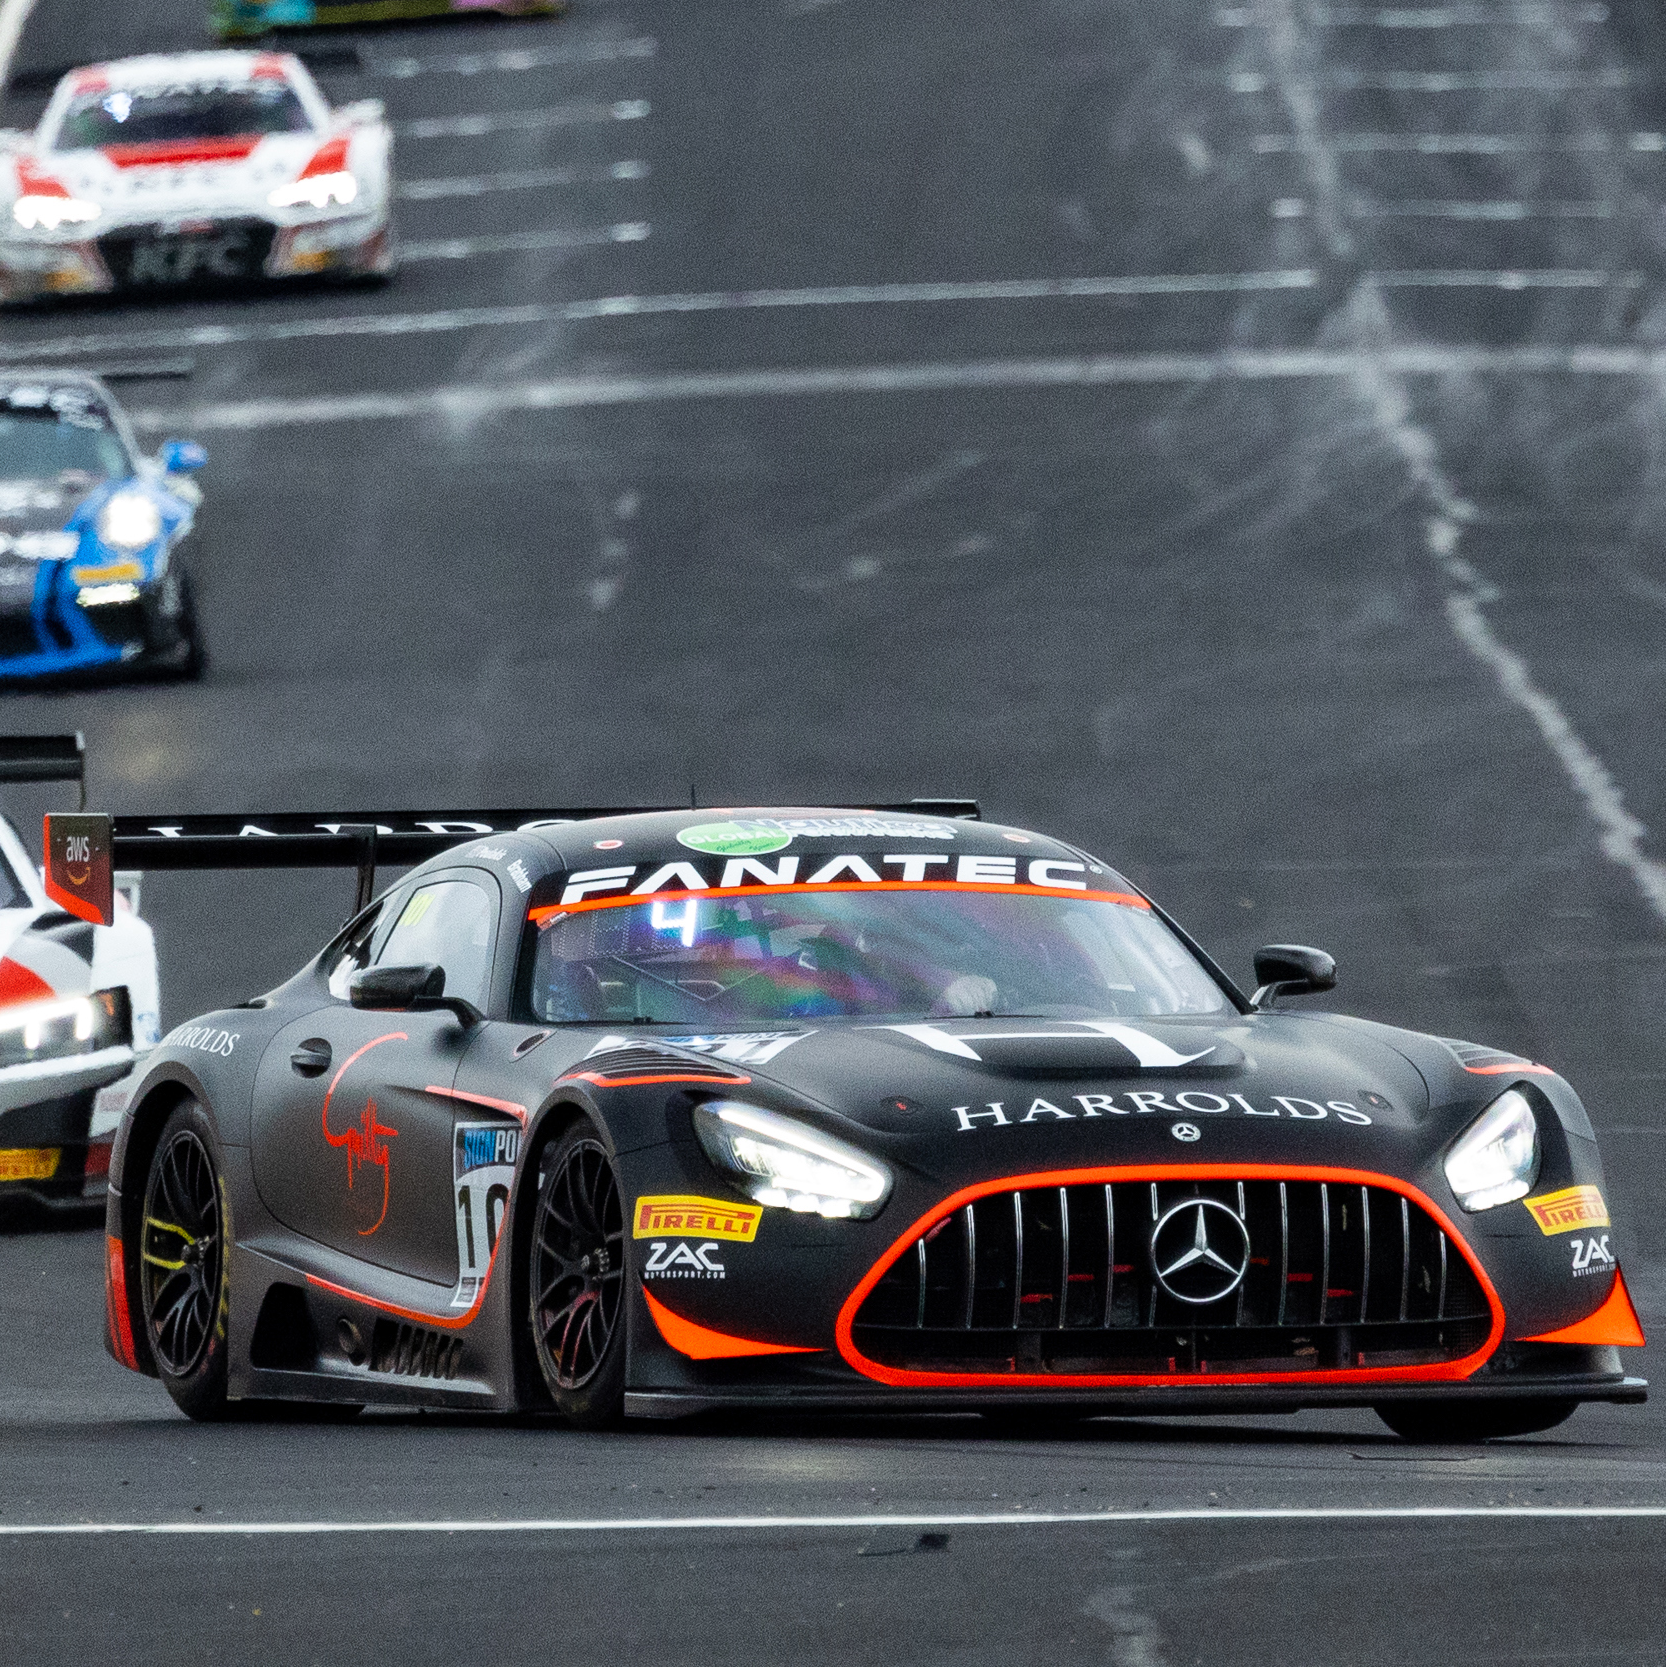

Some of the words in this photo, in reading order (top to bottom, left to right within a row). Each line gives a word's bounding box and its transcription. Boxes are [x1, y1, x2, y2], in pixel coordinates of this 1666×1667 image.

[66, 836, 90, 862] aws
[560, 854, 1089, 904] FANATEC
[652, 899, 698, 947] 4
[163, 1027, 241, 1057] ARROLDS
[951, 1092, 1372, 1132] HARROLDS
[639, 1204, 755, 1234] PIRELLI
[645, 1242, 724, 1271] ZAC
[1571, 1235, 1614, 1270] ZAC
[644, 1271, 725, 1279] MOTORSPORT.COM
